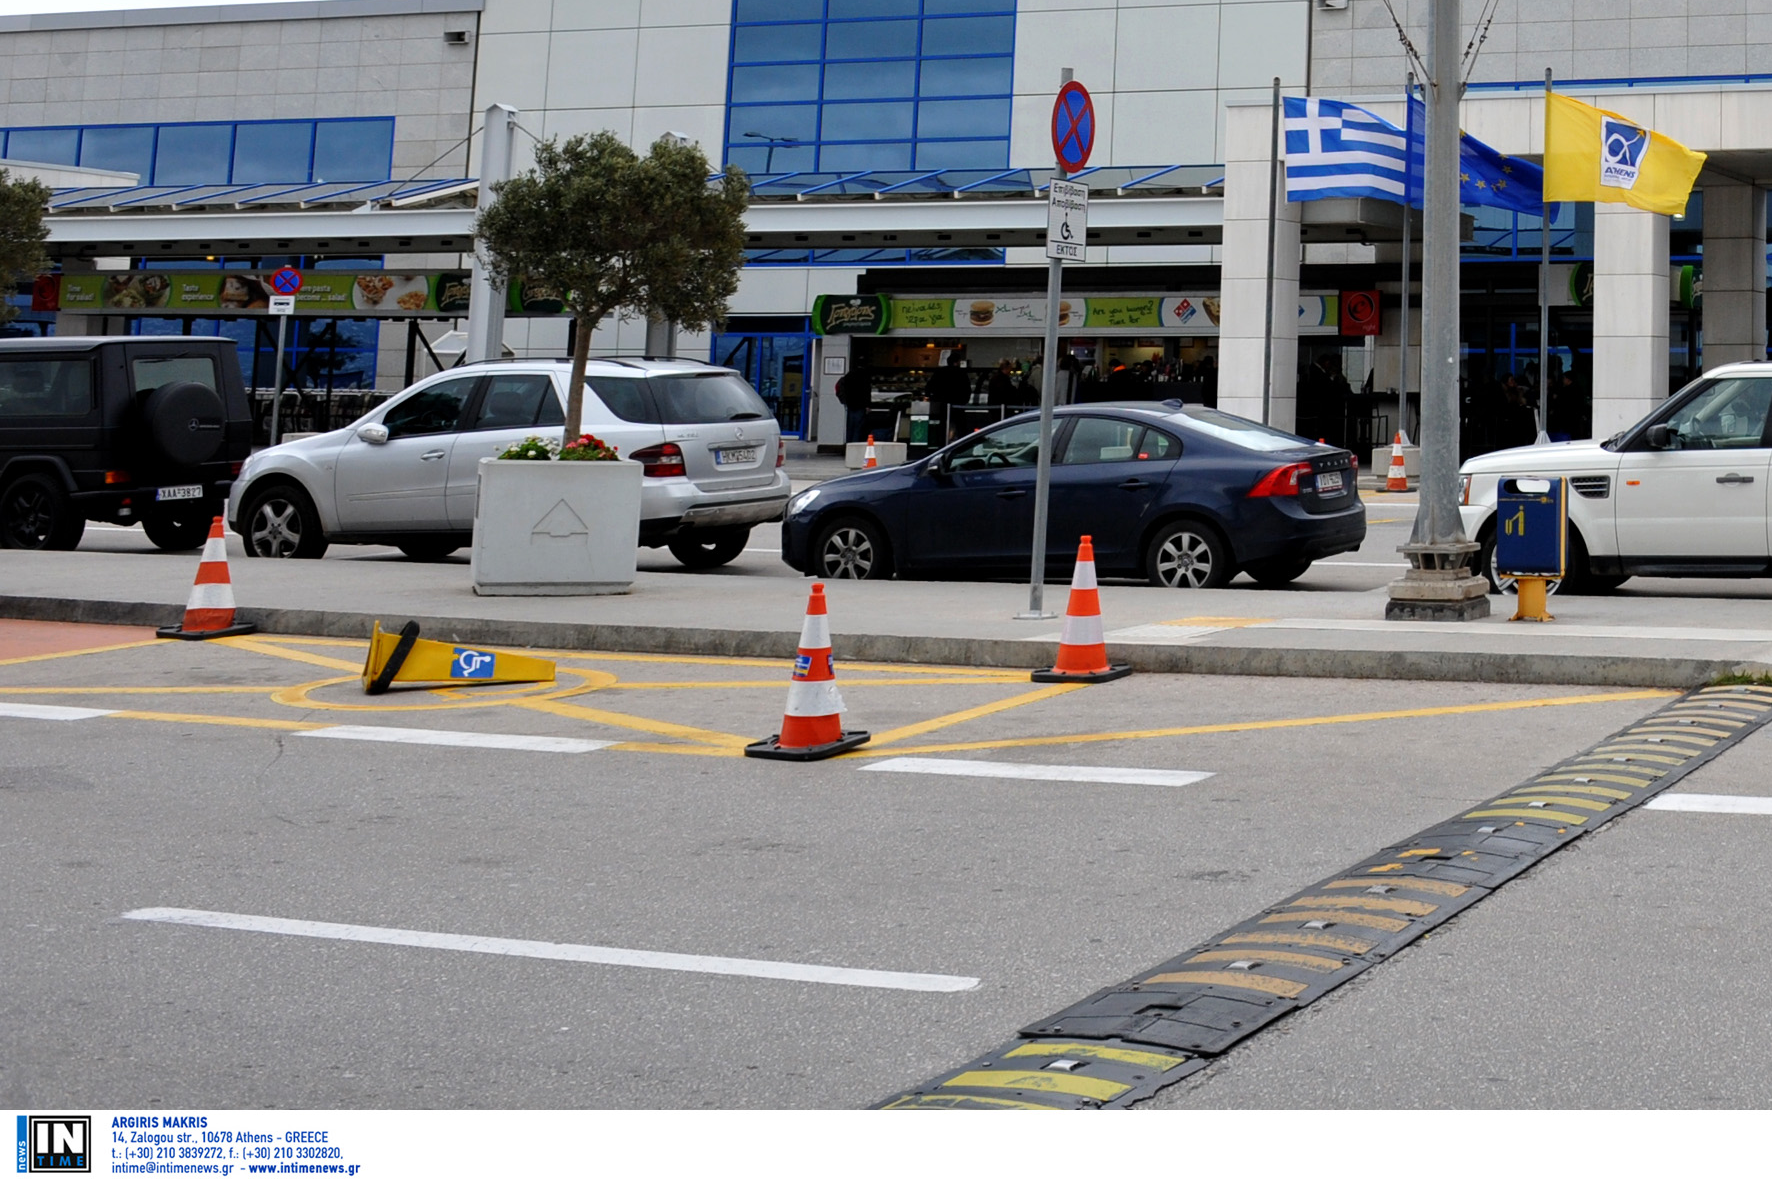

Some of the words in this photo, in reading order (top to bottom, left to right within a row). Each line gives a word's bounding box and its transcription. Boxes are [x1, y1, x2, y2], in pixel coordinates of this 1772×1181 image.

[1605, 166, 1636, 178] ATHENS
[1056, 244, 1077, 256] ΕΚΤΟΣ
[1093, 307, 1106, 315] Are
[1109, 308, 1122, 317] you
